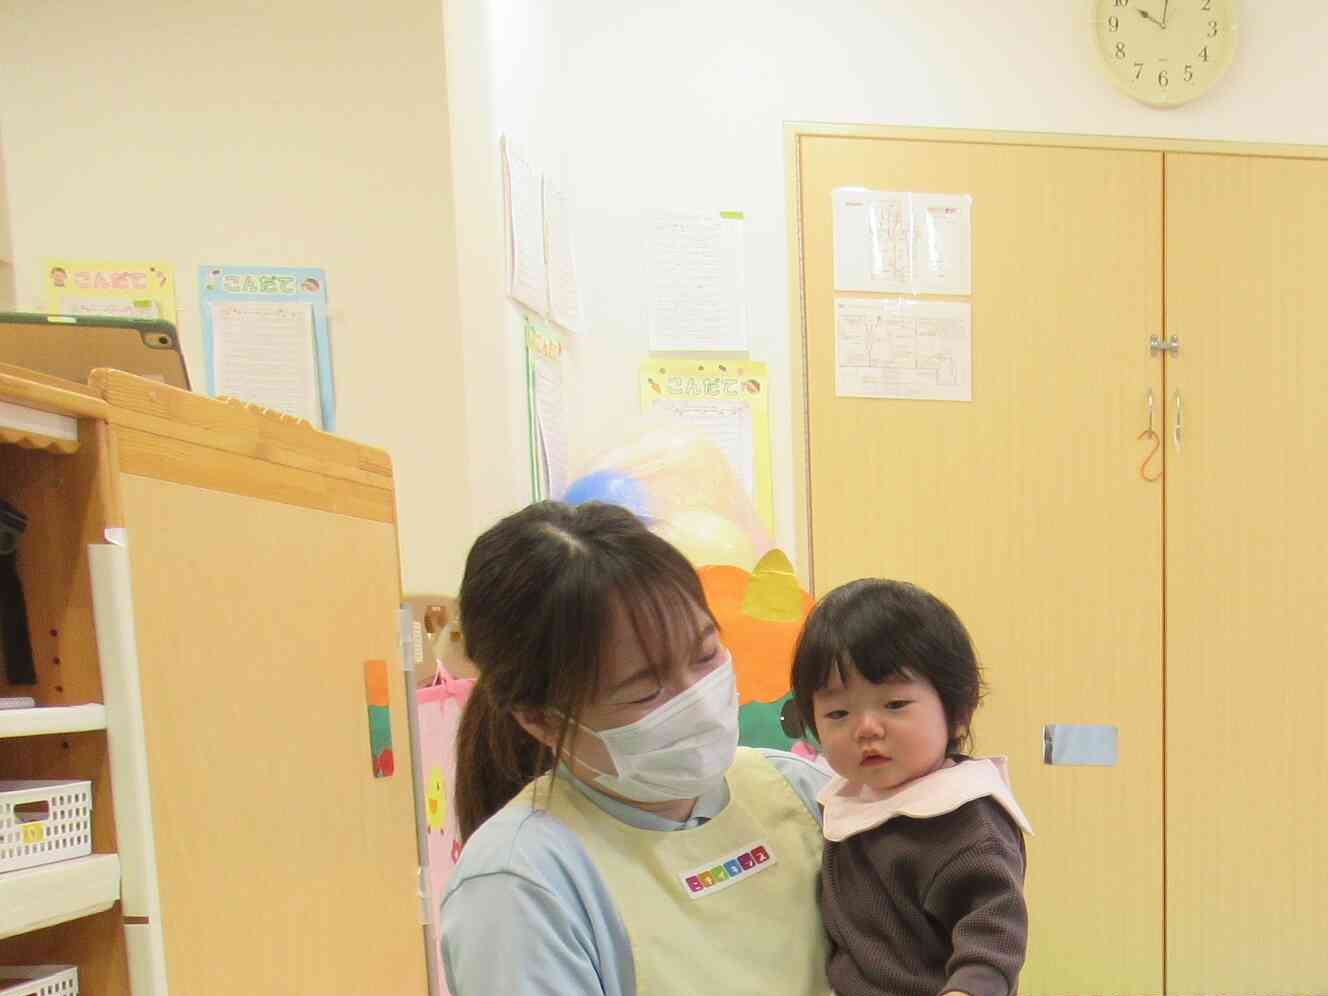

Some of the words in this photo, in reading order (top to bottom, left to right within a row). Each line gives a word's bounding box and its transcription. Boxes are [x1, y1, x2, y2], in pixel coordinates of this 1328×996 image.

[1107, 16, 1119, 32] 9
[1207, 20, 1218, 37] 3
[1115, 42, 1126, 59] 8
[1198, 45, 1209, 62] 4
[1134, 62, 1144, 79] 7
[1158, 70, 1168, 87] 6
[1183, 64, 1193, 81] 5
[74, 271, 147, 290] こんだて
[223, 275, 297, 294] こんだて
[669, 377, 739, 397] こんだて
